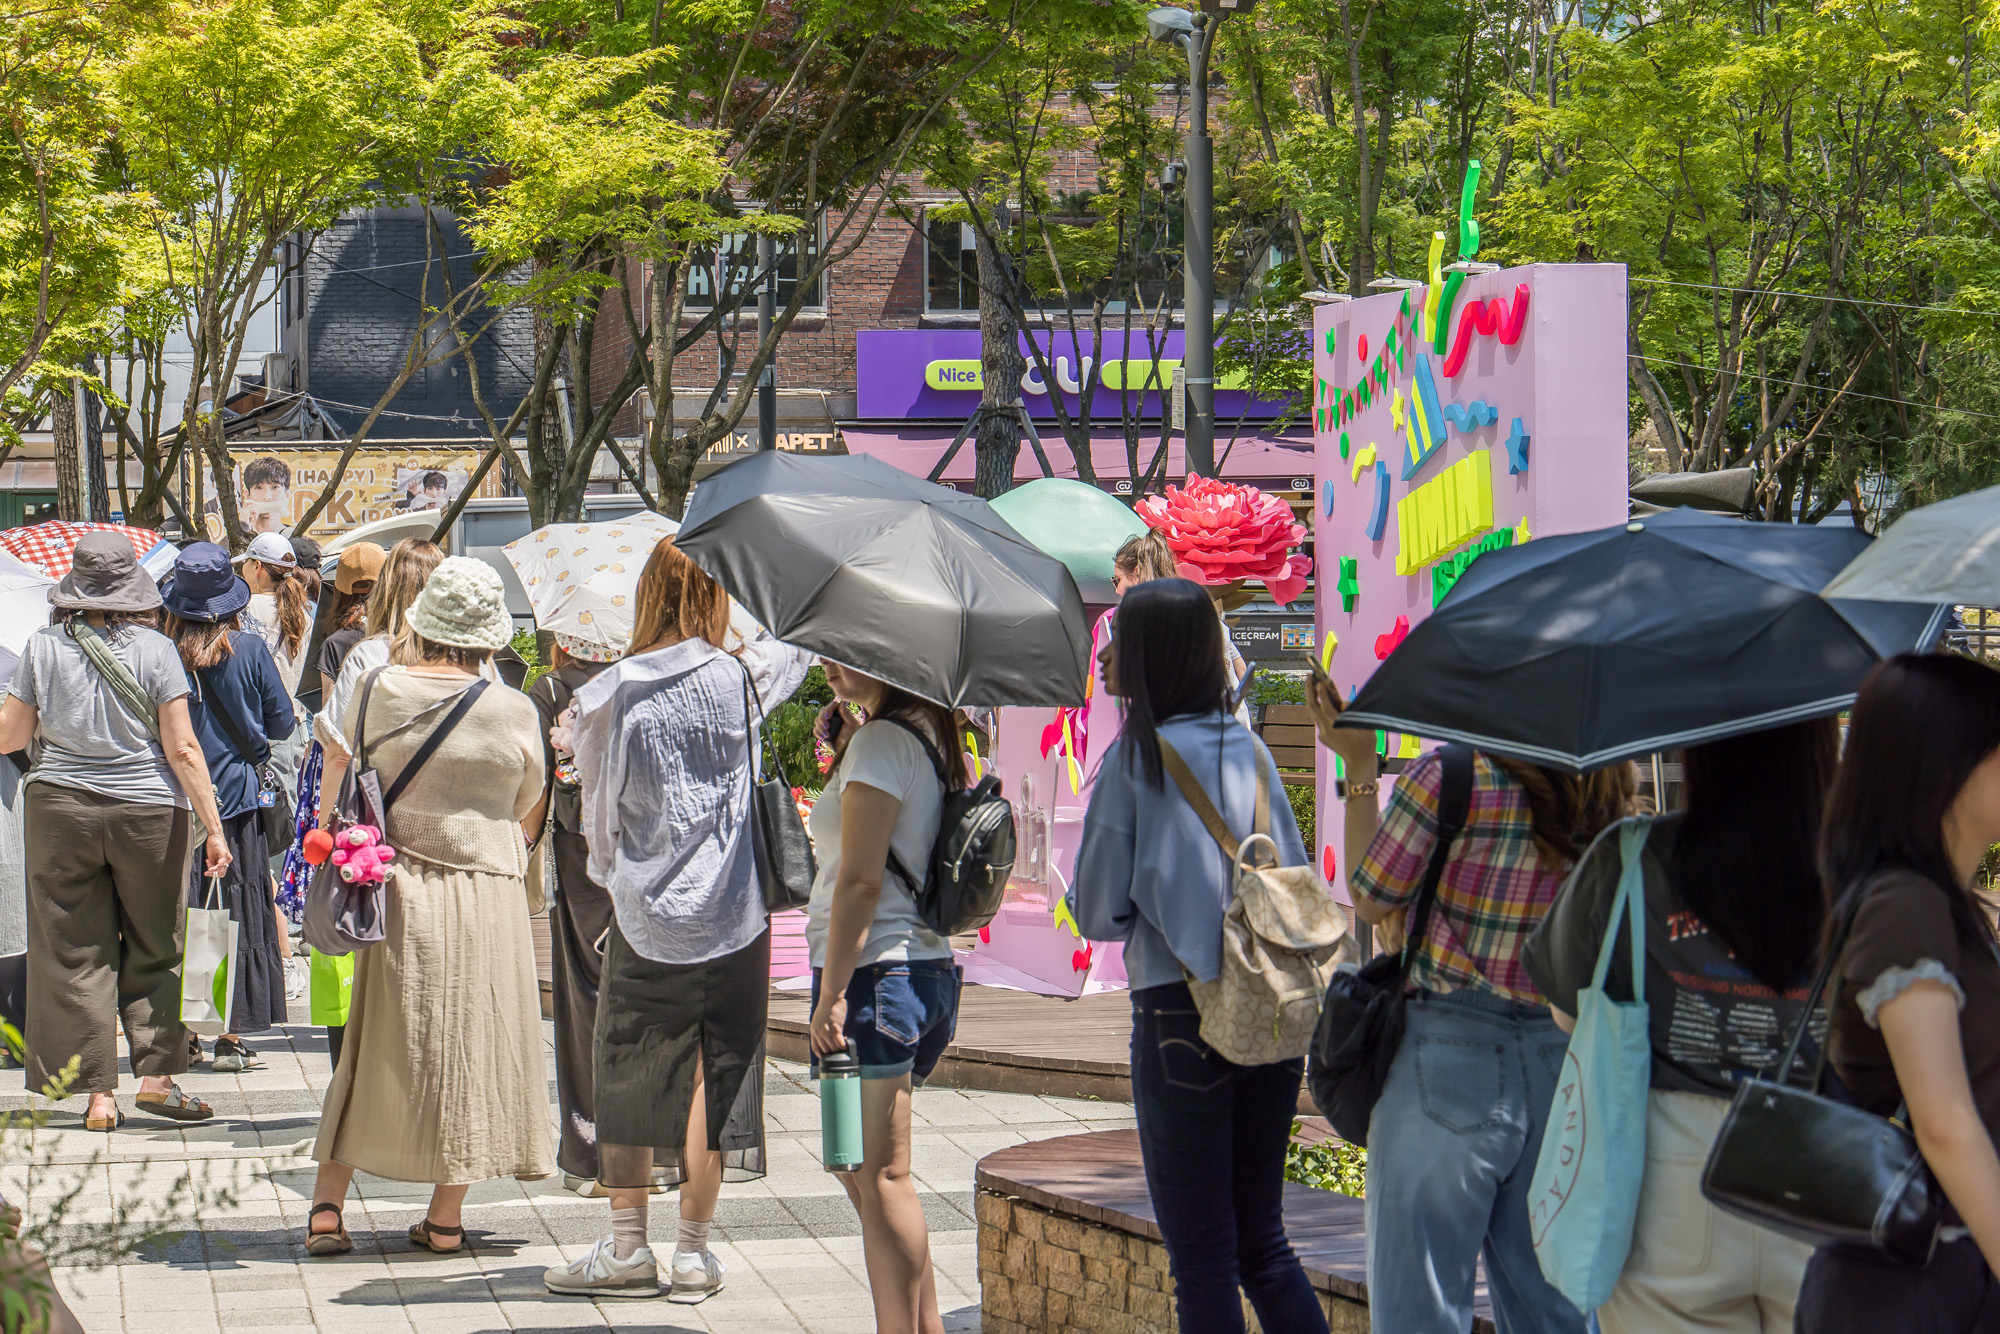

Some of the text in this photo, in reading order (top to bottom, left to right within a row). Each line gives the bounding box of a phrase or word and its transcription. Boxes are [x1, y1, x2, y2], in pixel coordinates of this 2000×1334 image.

[938, 368, 976, 382] Nice
[1020, 355, 1093, 395] CU
[757, 433, 833, 450] APET
[294, 490, 356, 524] DK
[1395, 450, 1494, 576] JIMIN
[1232, 632, 1279, 640] ICECREAM
